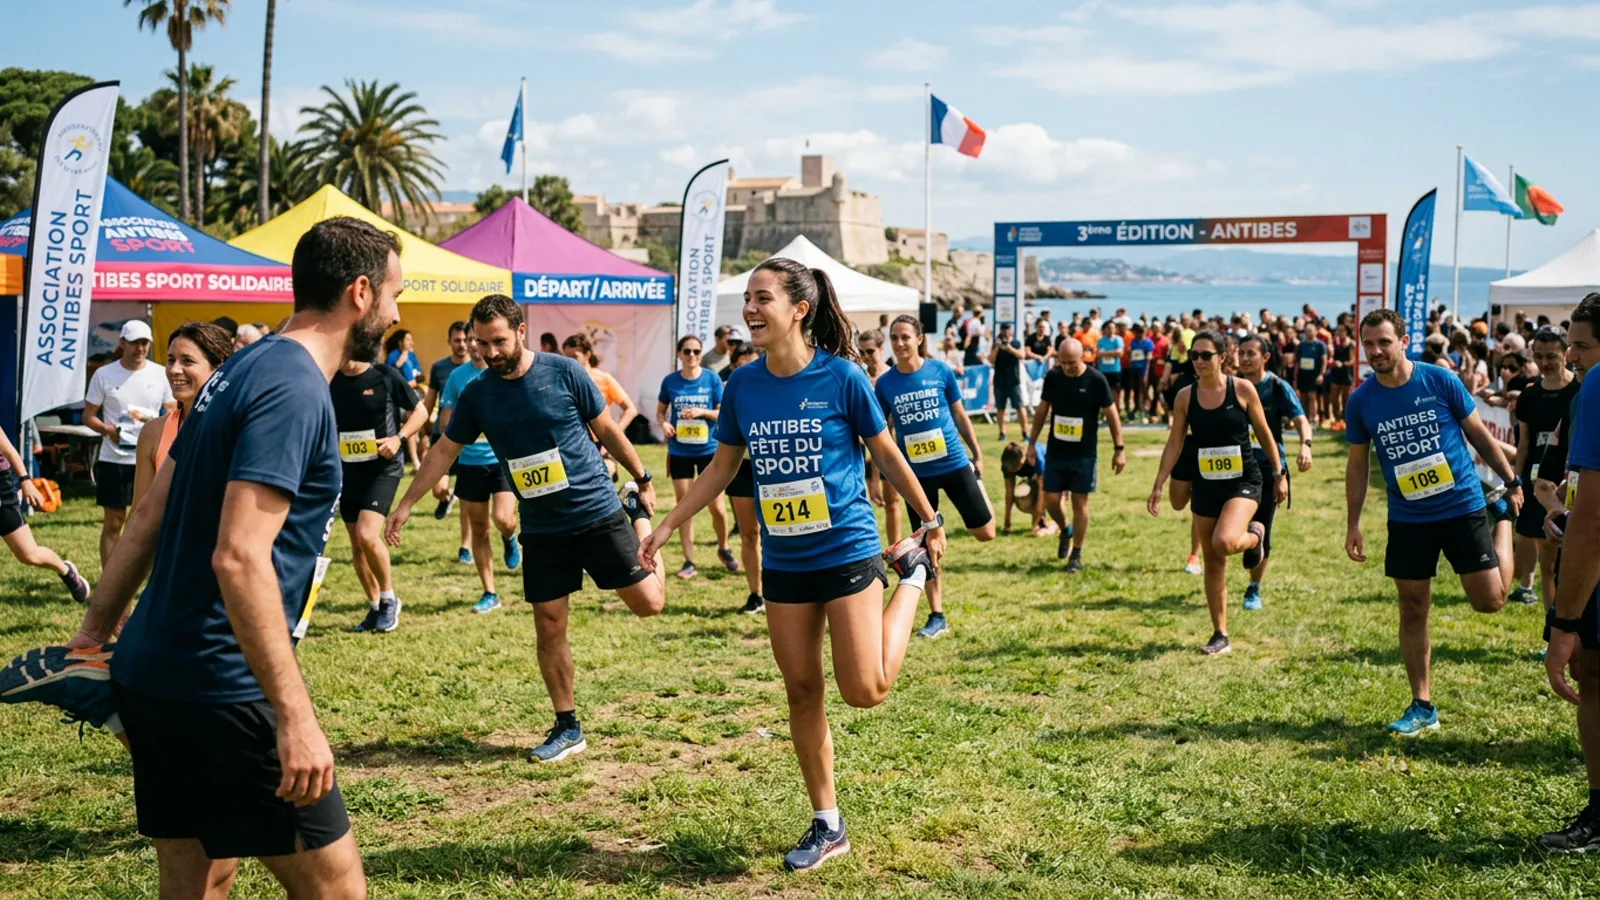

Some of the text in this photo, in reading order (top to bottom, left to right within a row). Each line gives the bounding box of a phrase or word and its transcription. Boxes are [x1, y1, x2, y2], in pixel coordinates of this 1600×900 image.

[69, 189, 92, 265] SPORT
[1116, 221, 1194, 241] ÉDITION
[1211, 221, 1298, 240] ANTIBES
[110, 238, 196, 254] SPORT
[37, 211, 67, 366] ASSOCIATION
[145, 272, 204, 289] SPORT
[208, 273, 293, 291] SOLIDAIRE
[441, 280, 504, 293] SOLIDAIRE
[524, 275, 666, 300] DÉPART/ARRIVÉE
[59, 273, 83, 370] ANTIBES
[749, 418, 823, 436] ANTIBES
[1377, 409, 1437, 434] ANTIBES
[1418, 422, 1439, 437] DU
[345, 441, 368, 454] 103
[750, 437, 823, 455] FÊTE DU
[1386, 435, 1441, 460] SPORT
[755, 454, 823, 475] SPORT
[522, 466, 549, 487] 307
[1408, 469, 1440, 489] 108
[773, 499, 811, 522] 214
